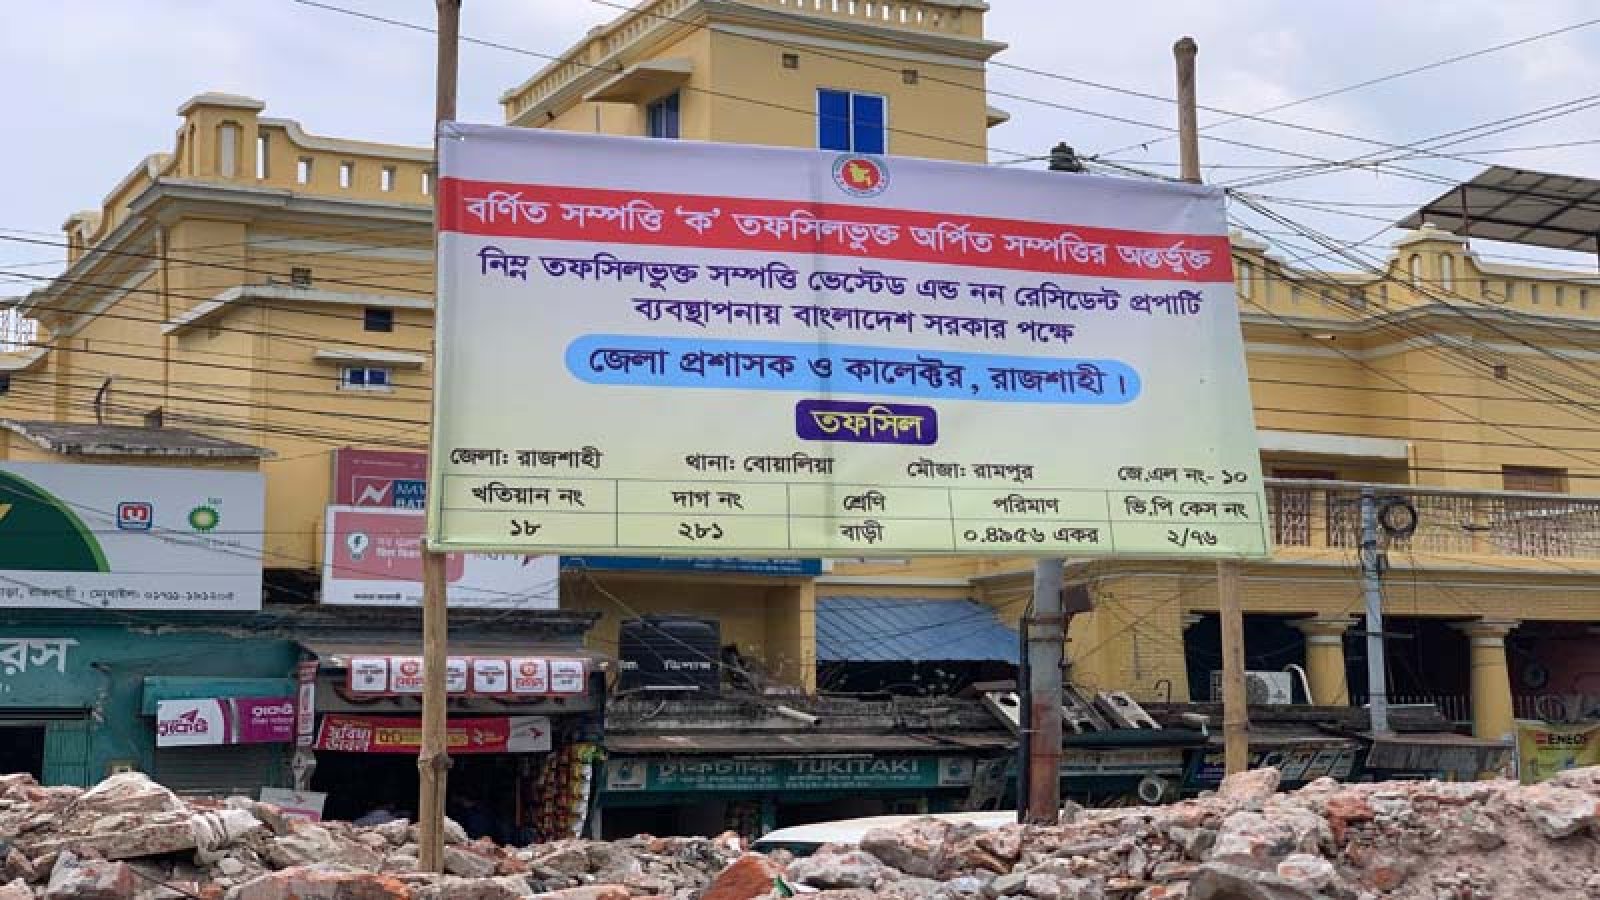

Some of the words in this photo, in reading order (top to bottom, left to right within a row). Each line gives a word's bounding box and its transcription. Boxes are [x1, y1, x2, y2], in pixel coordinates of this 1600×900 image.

[463, 189, 551, 225] বর্ণিত
[559, 199, 665, 233] সম্পত্তি
[909, 221, 995, 253] অর্পিত
[1001, 231, 1109, 265] সম্পত্তির
[477, 245, 531, 281] নিম্ন
[705, 261, 799, 291] সম্পত্তি
[807, 267, 907, 295] ভেস্টেড
[915, 279, 961, 301] এন্ড
[967, 283, 1007, 305] নন
[1015, 281, 1121, 311] রেসিডেন্ট
[1129, 289, 1203, 315] প্রপার্টি
[631, 297, 783, 329] ব্যবস্থাপনায়
[789, 303, 917, 333] বাংলাদেশ
[921, 313, 1009, 339] সরকার
[1015, 319, 1075, 343] পক্ষে
[589, 348, 671, 375] জেলা
[679, 349, 797, 379] প্রশাসক
[807, 357, 833, 379] ও
[811, 405, 923, 439] তফসিল
[515, 445, 603, 469] রাজশাহী
[743, 451, 835, 475] বোয়ালিয়া
[971, 463, 1035, 483] রামপুর
[1221, 469, 1249, 485] ১০
[471, 481, 551, 505] খতিয়ান
[557, 487, 585, 507] নং
[671, 490, 711, 509] দাগ
[715, 491, 743, 509] নং
[993, 493, 1059, 514] পরিমাণ
[1179, 501, 1217, 517] কেস
[1221, 503, 1249, 519] নং
[509, 519, 541, 537] ১৮
[679, 523, 723, 541] ২৮১
[839, 519, 885, 545] বাড়ী
[1053, 527, 1099, 545] একর
[796, 759, 920, 773] TUKITAKI
